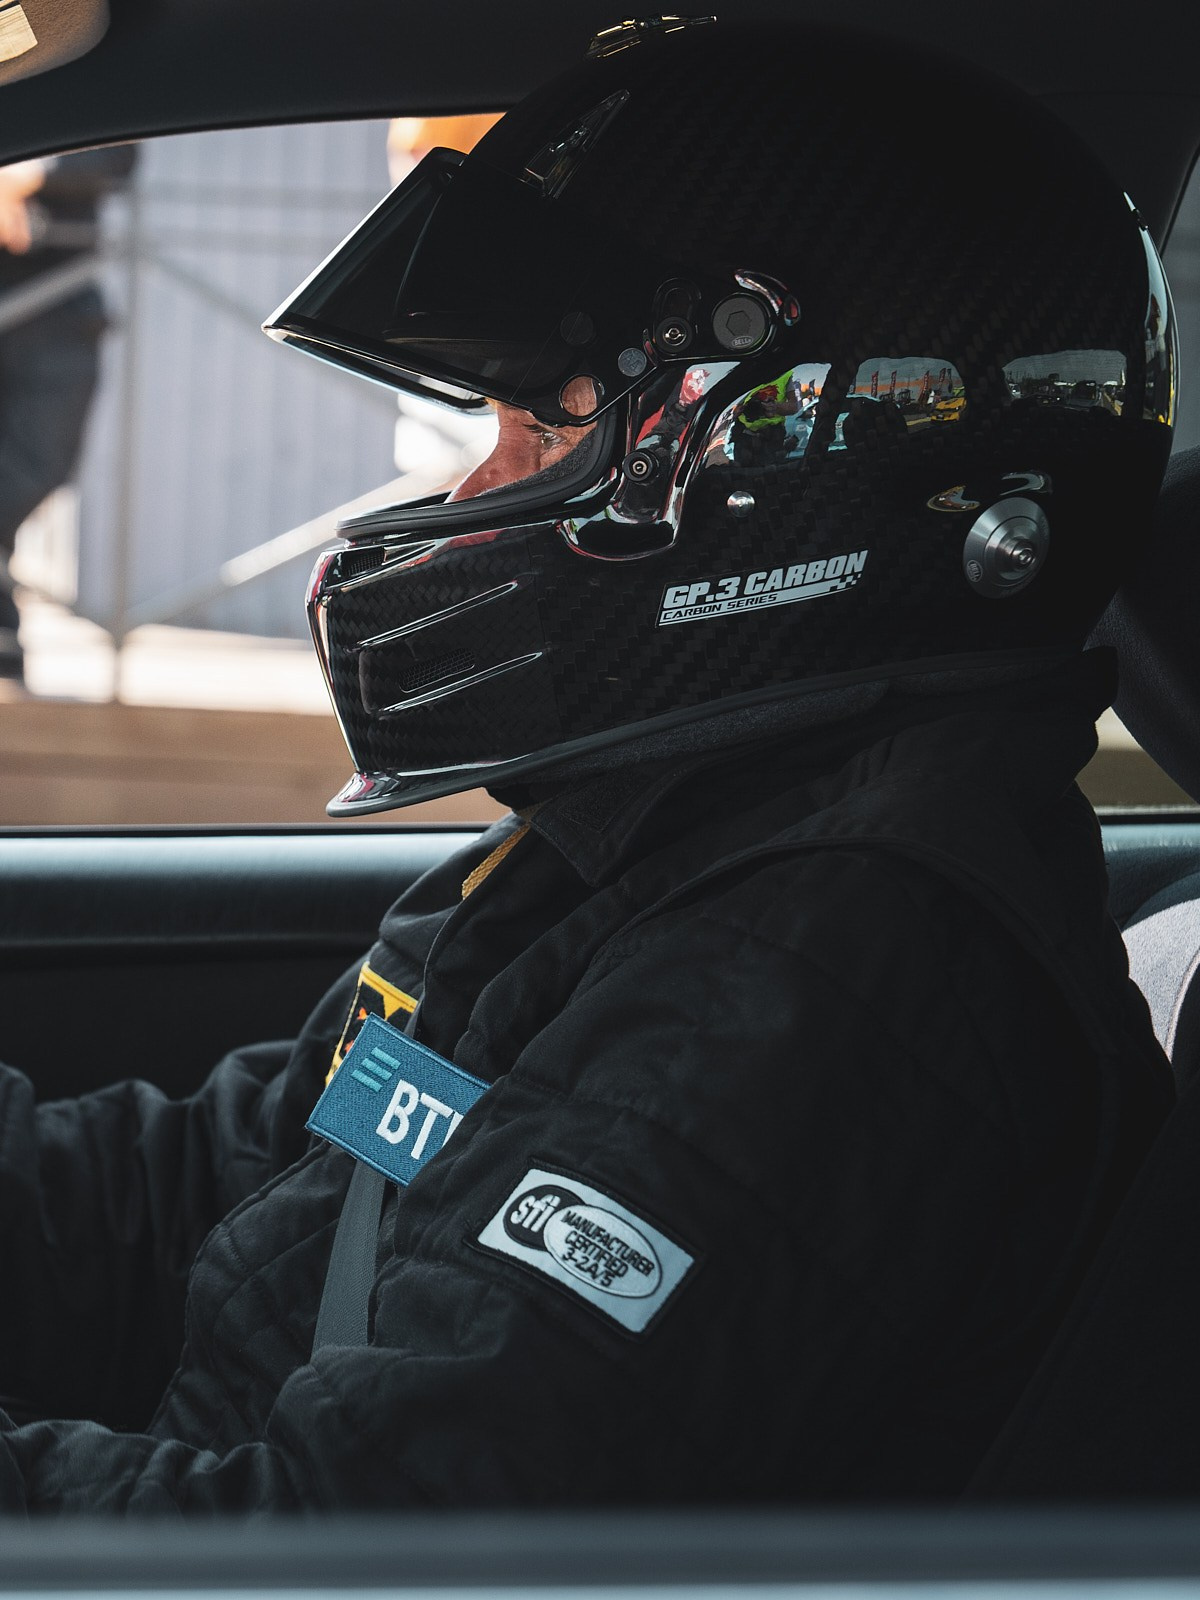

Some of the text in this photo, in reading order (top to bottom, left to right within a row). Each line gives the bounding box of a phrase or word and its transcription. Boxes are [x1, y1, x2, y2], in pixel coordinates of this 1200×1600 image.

[663, 550, 868, 609] GP.3 CARBON
[663, 593, 778, 620] CARBON SERIES
[561, 1210, 655, 1276] MANUFACTURER
[565, 1230, 629, 1277] CERTIFIED
[562, 1247, 615, 1287] 3-2A/5
